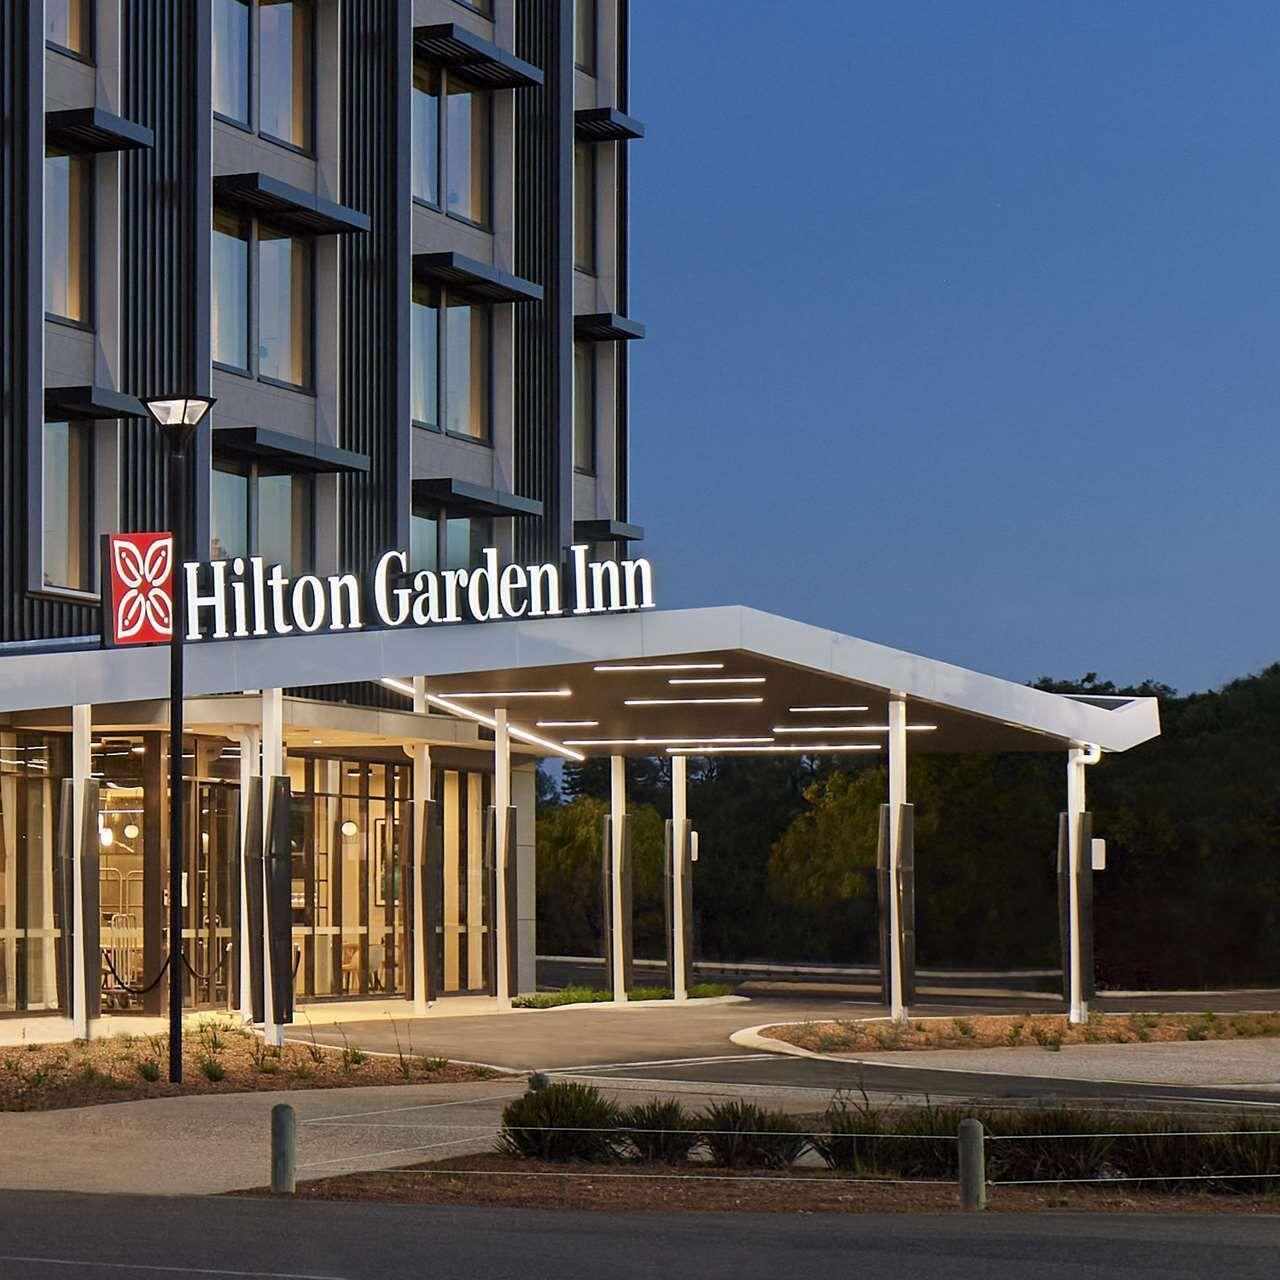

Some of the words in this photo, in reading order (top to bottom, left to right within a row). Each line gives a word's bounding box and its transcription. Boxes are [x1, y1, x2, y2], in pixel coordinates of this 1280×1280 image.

[183, 556, 362, 640] Hilton
[374, 547, 563, 627] Garden
[570, 544, 656, 615] Inn
